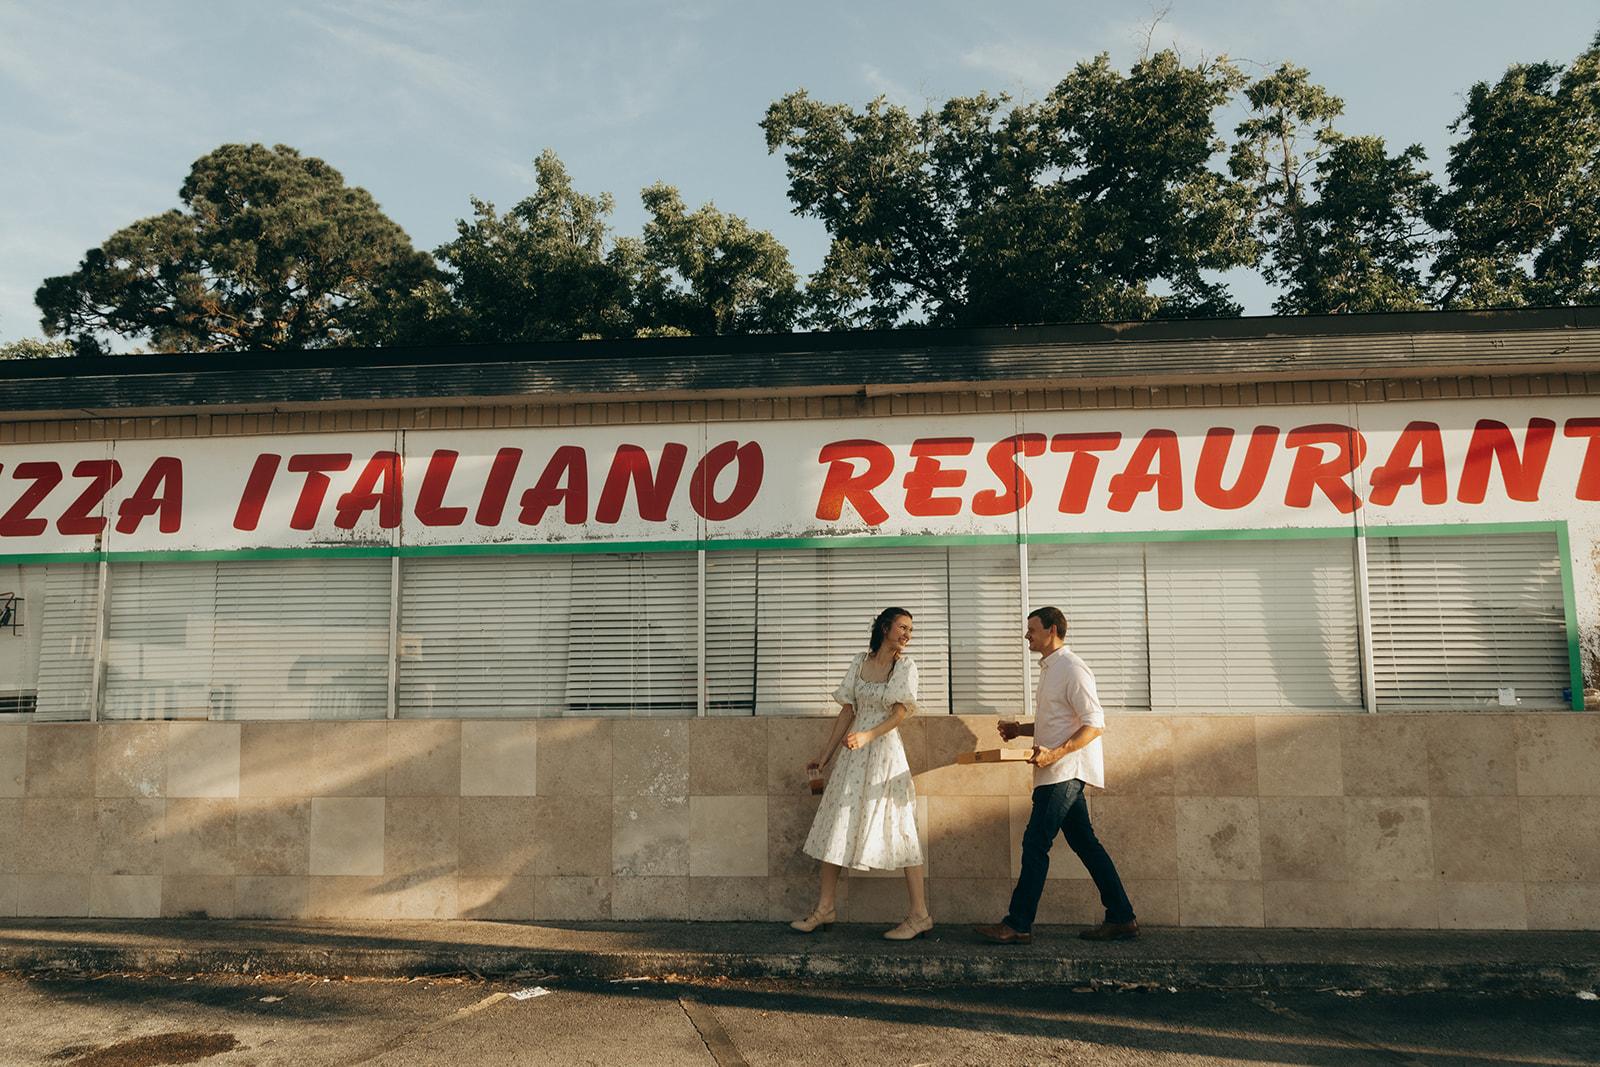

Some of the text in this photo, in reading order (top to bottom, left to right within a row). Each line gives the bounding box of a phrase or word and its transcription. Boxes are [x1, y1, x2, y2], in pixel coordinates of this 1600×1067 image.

[0, 416, 1600, 536] ZZA ITALIANO RESTAURANT
